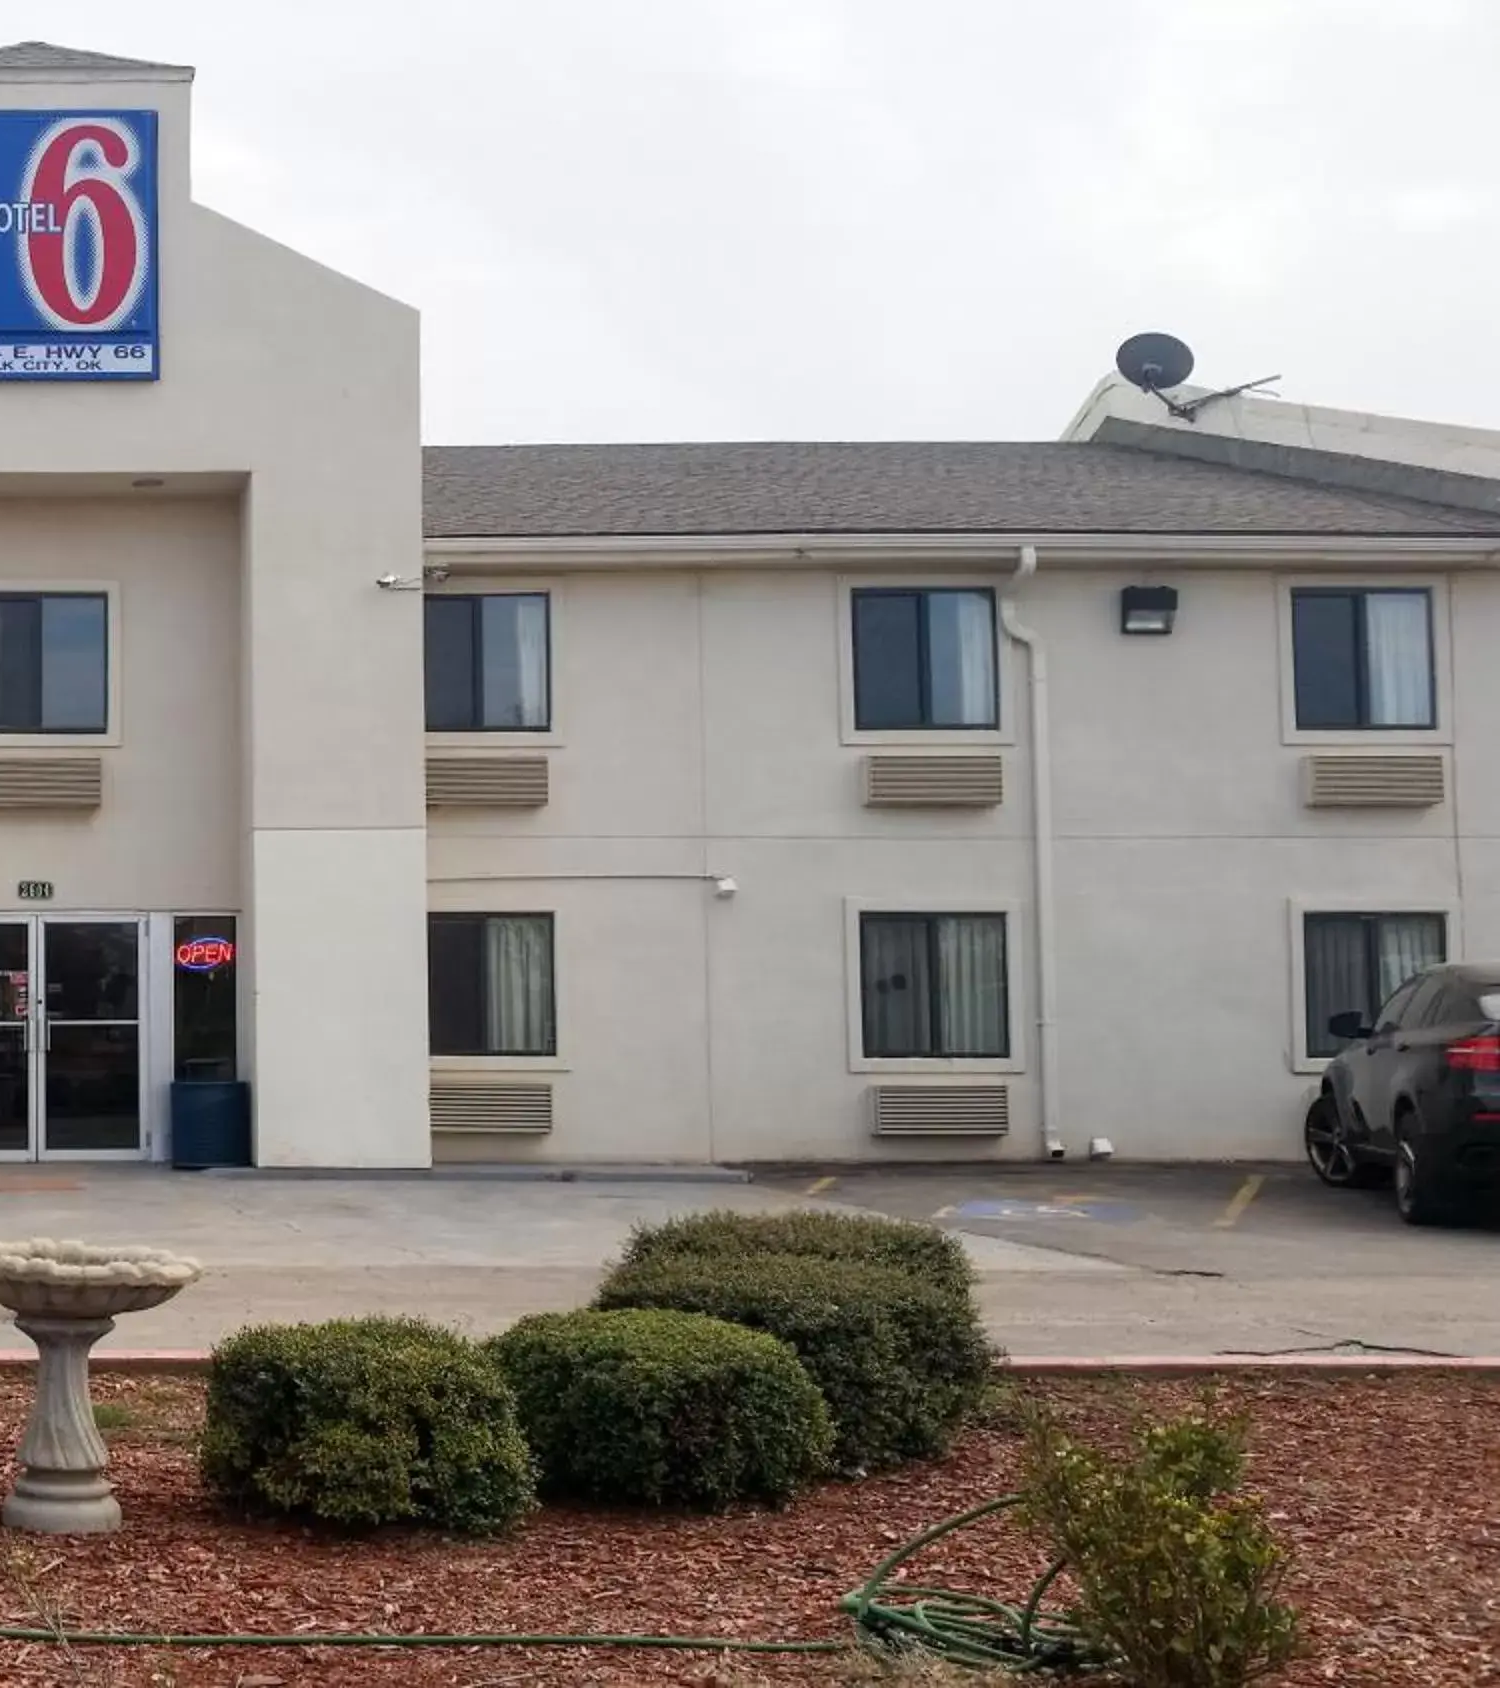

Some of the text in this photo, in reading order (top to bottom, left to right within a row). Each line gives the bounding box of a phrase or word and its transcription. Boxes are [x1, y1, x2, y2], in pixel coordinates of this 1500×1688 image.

[28, 124, 137, 325] 6
[13, 346, 35, 359] E.
[45, 346, 102, 359] HWY
[114, 346, 146, 359] 66
[76, 360, 102, 371] OK
[177, 944, 233, 964] OPEN
